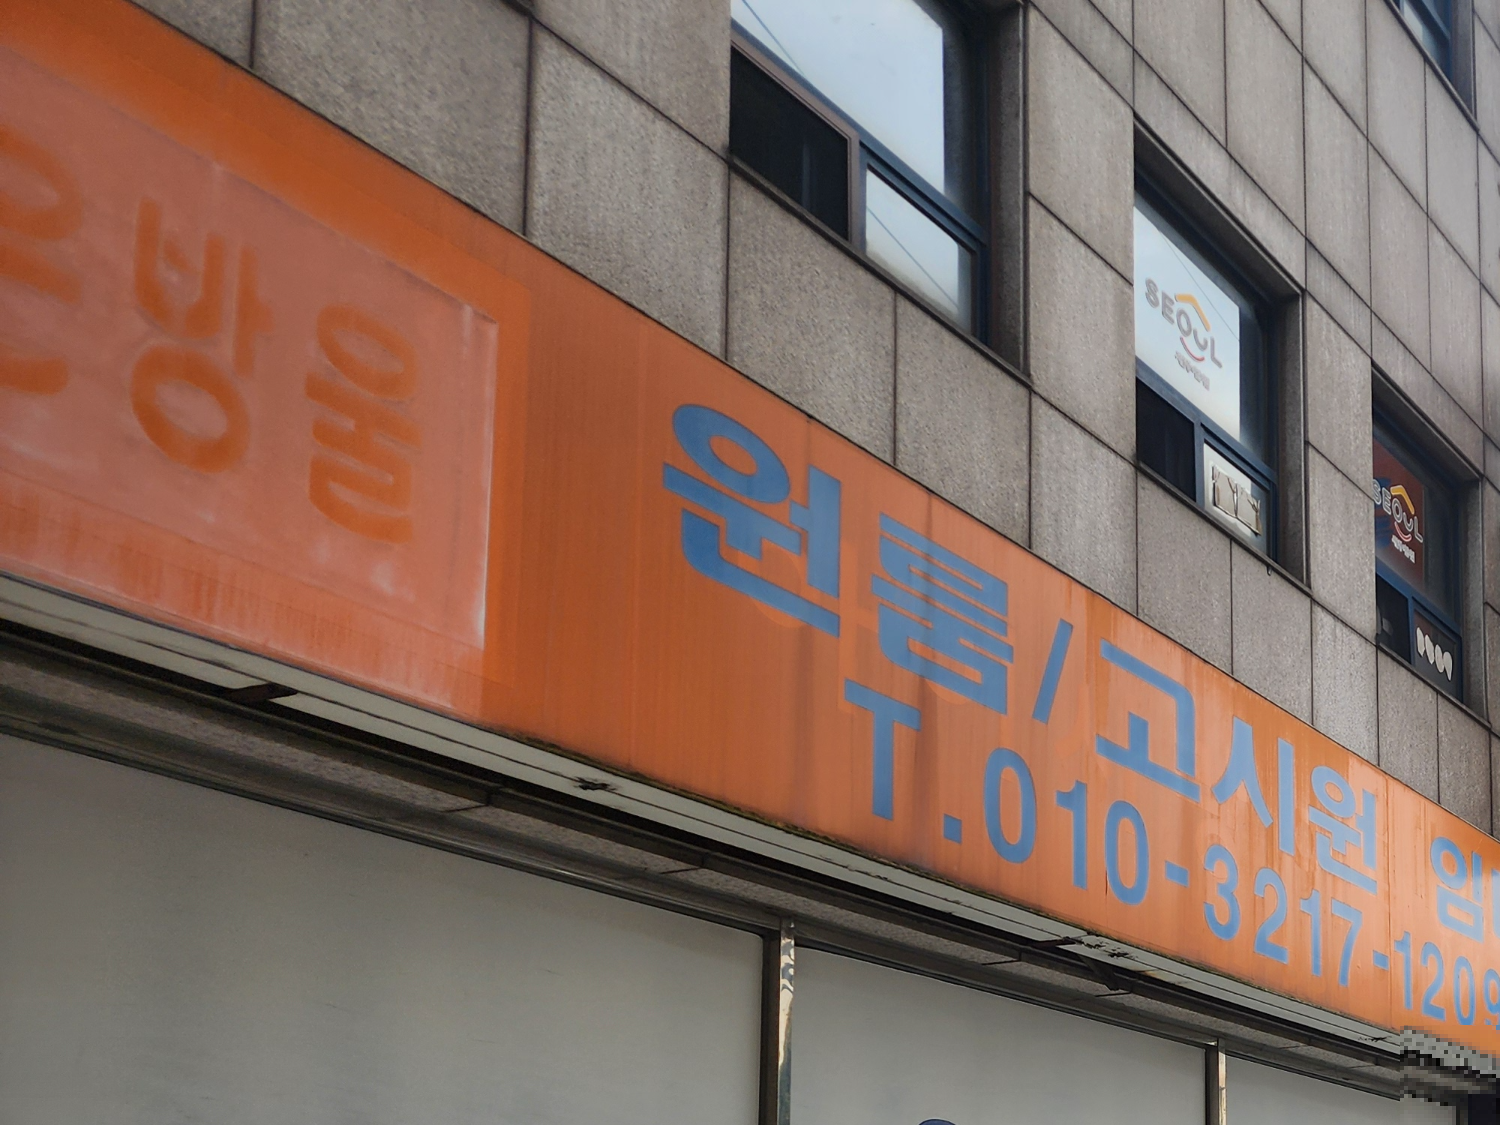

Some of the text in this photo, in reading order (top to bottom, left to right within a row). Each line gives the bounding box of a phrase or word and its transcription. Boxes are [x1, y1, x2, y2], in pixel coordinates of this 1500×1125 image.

[1144, 276, 1223, 369] SEOUL
[1373, 477, 1424, 544] SEOUL
[664, 402, 1379, 893] 원룸/고시원
